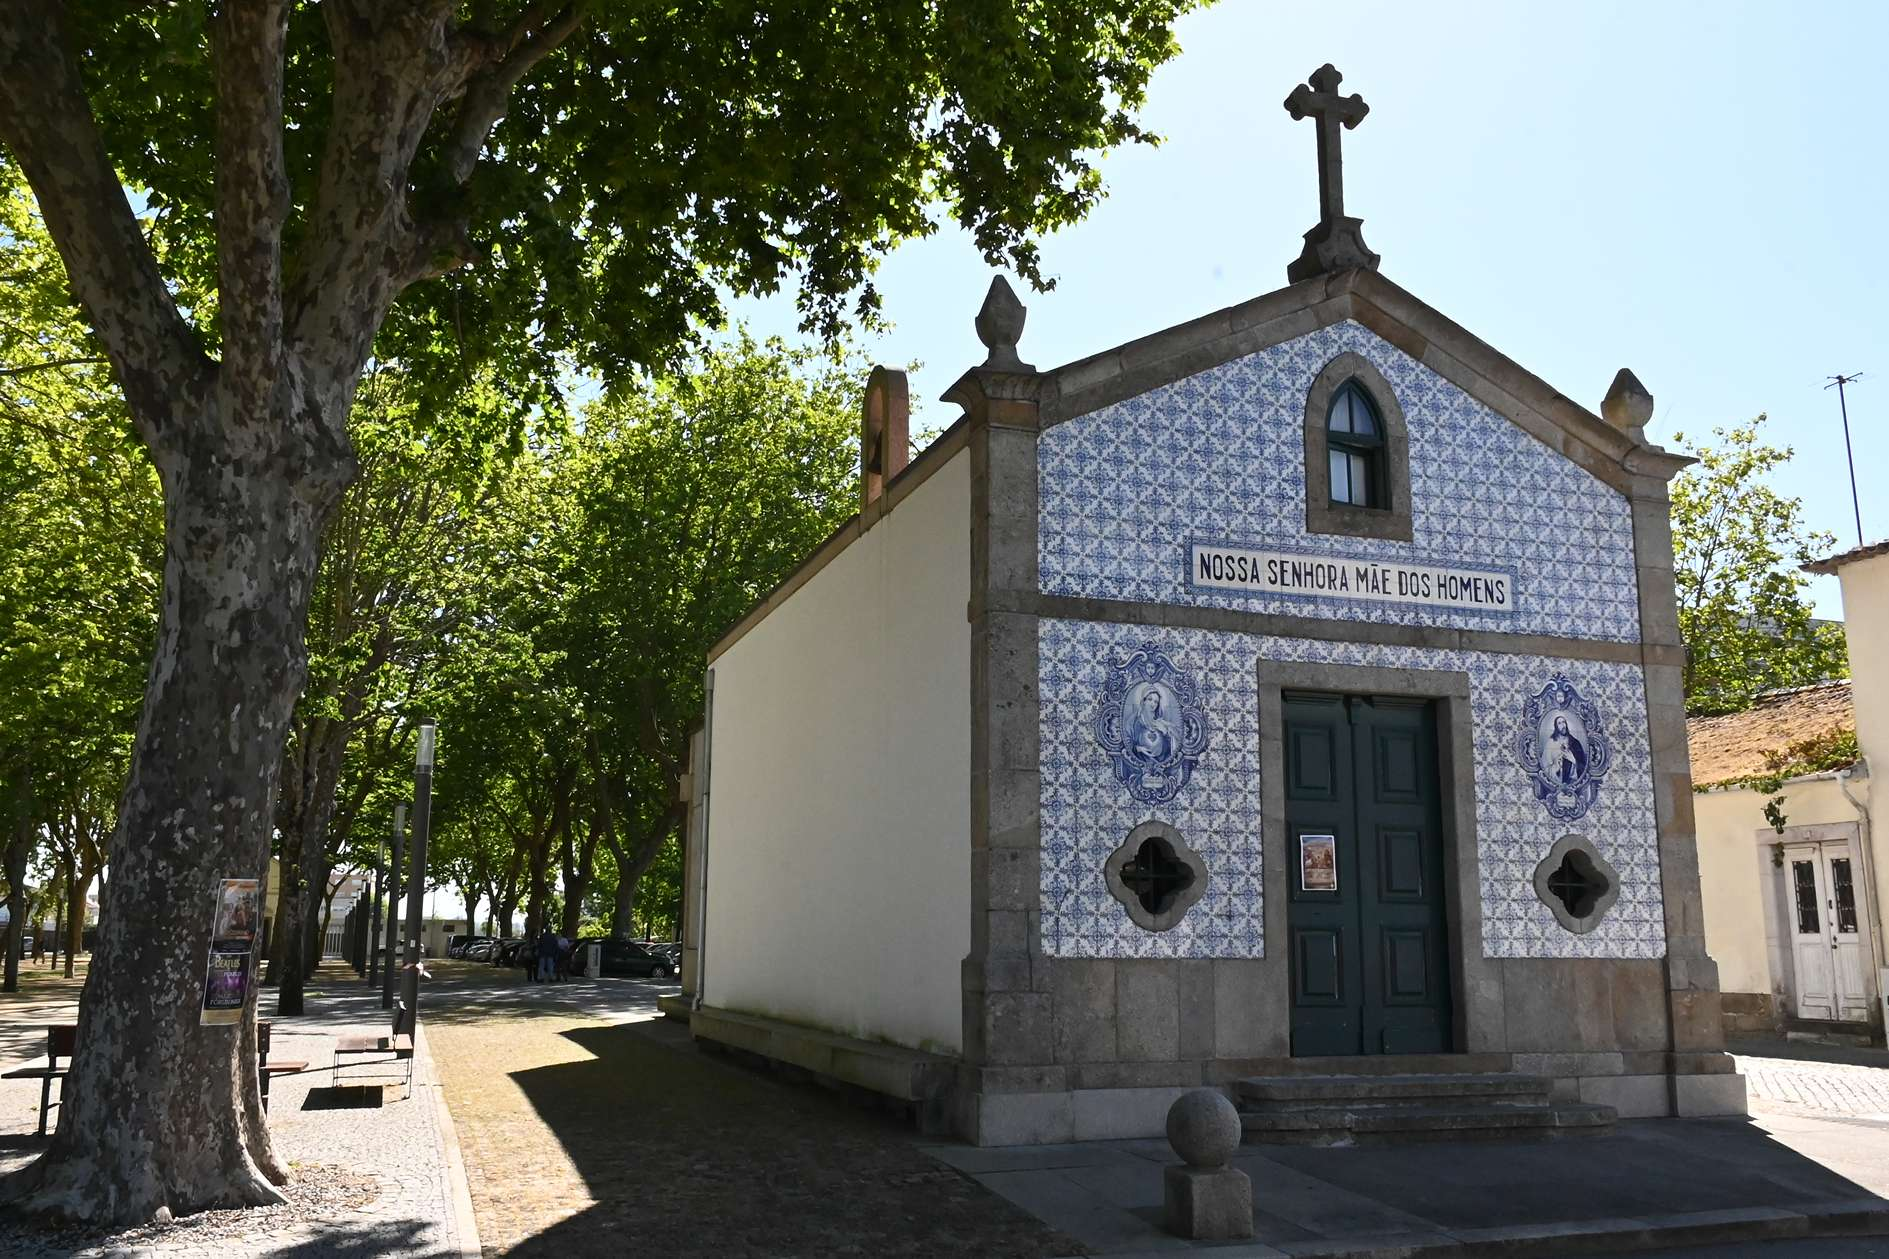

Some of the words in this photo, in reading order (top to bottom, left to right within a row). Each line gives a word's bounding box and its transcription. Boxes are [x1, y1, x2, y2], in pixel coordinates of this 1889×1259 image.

[1199, 553, 1260, 584] NOSSA
[1267, 559, 1349, 592] SENHORA
[1398, 571, 1430, 598] DOS
[1437, 574, 1505, 605] HOMENS
